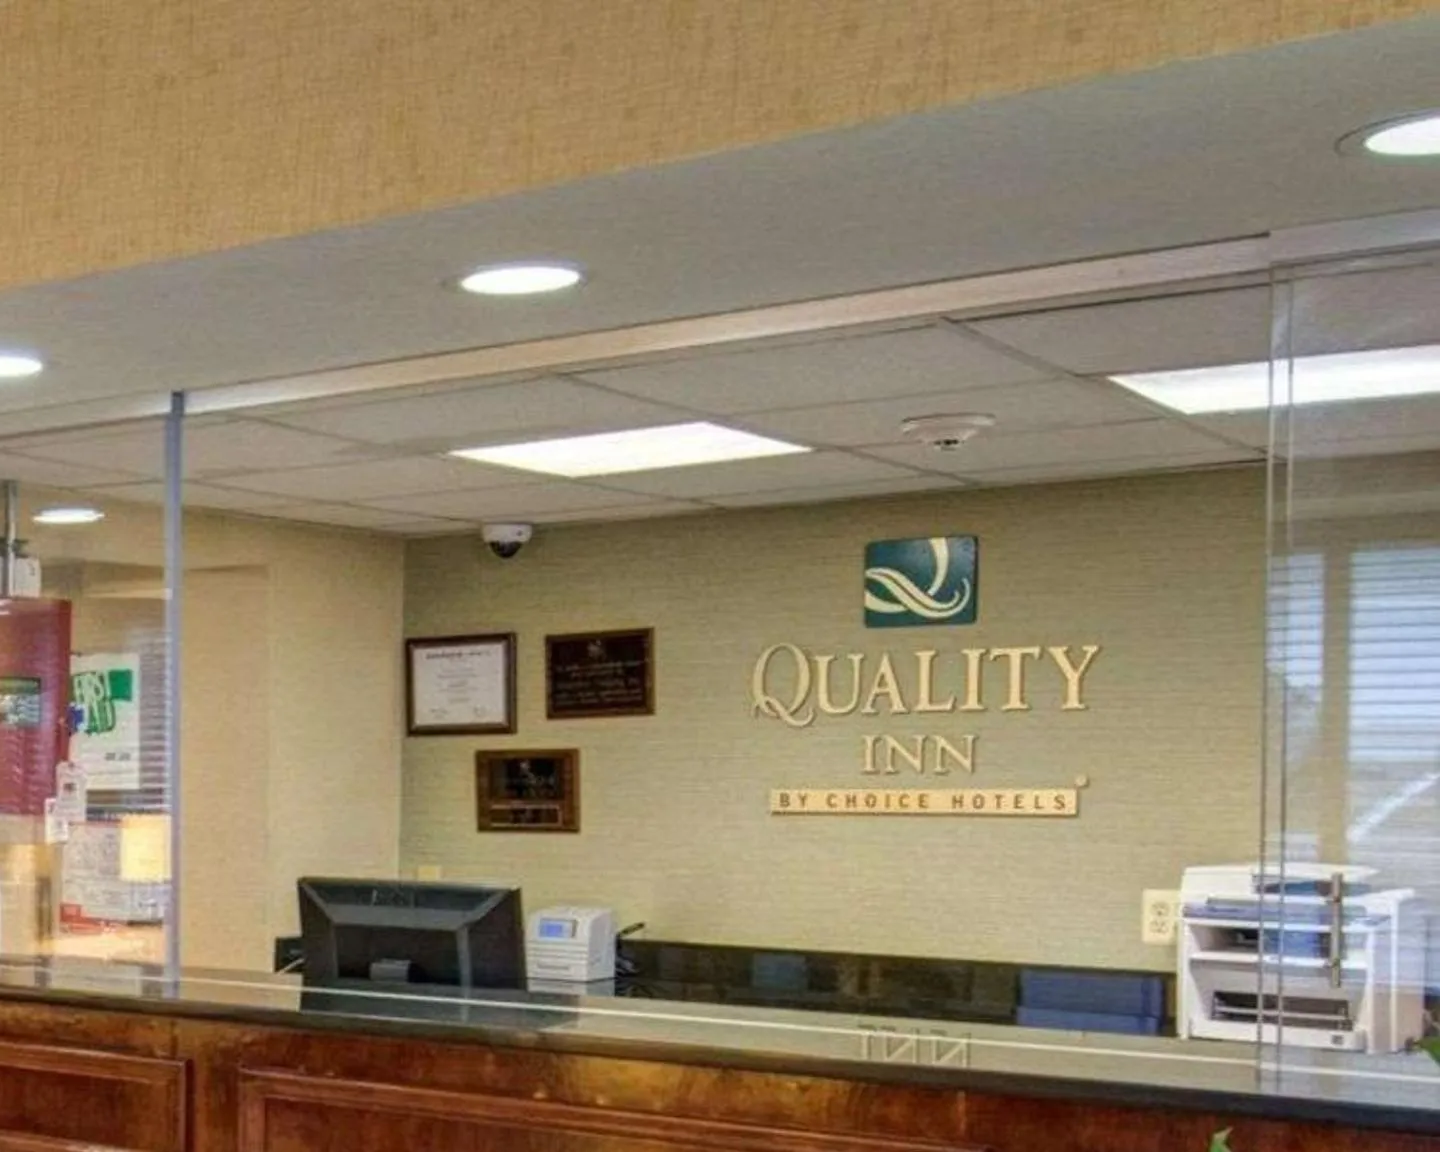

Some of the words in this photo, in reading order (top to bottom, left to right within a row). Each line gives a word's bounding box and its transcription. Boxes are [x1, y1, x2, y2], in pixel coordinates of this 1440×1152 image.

[753, 642, 1100, 727] QUALITY
[861, 734, 978, 774] INN
[778, 793, 809, 809] BY
[826, 793, 930, 810] CHOICE
[951, 793, 1067, 811] HOTELS
